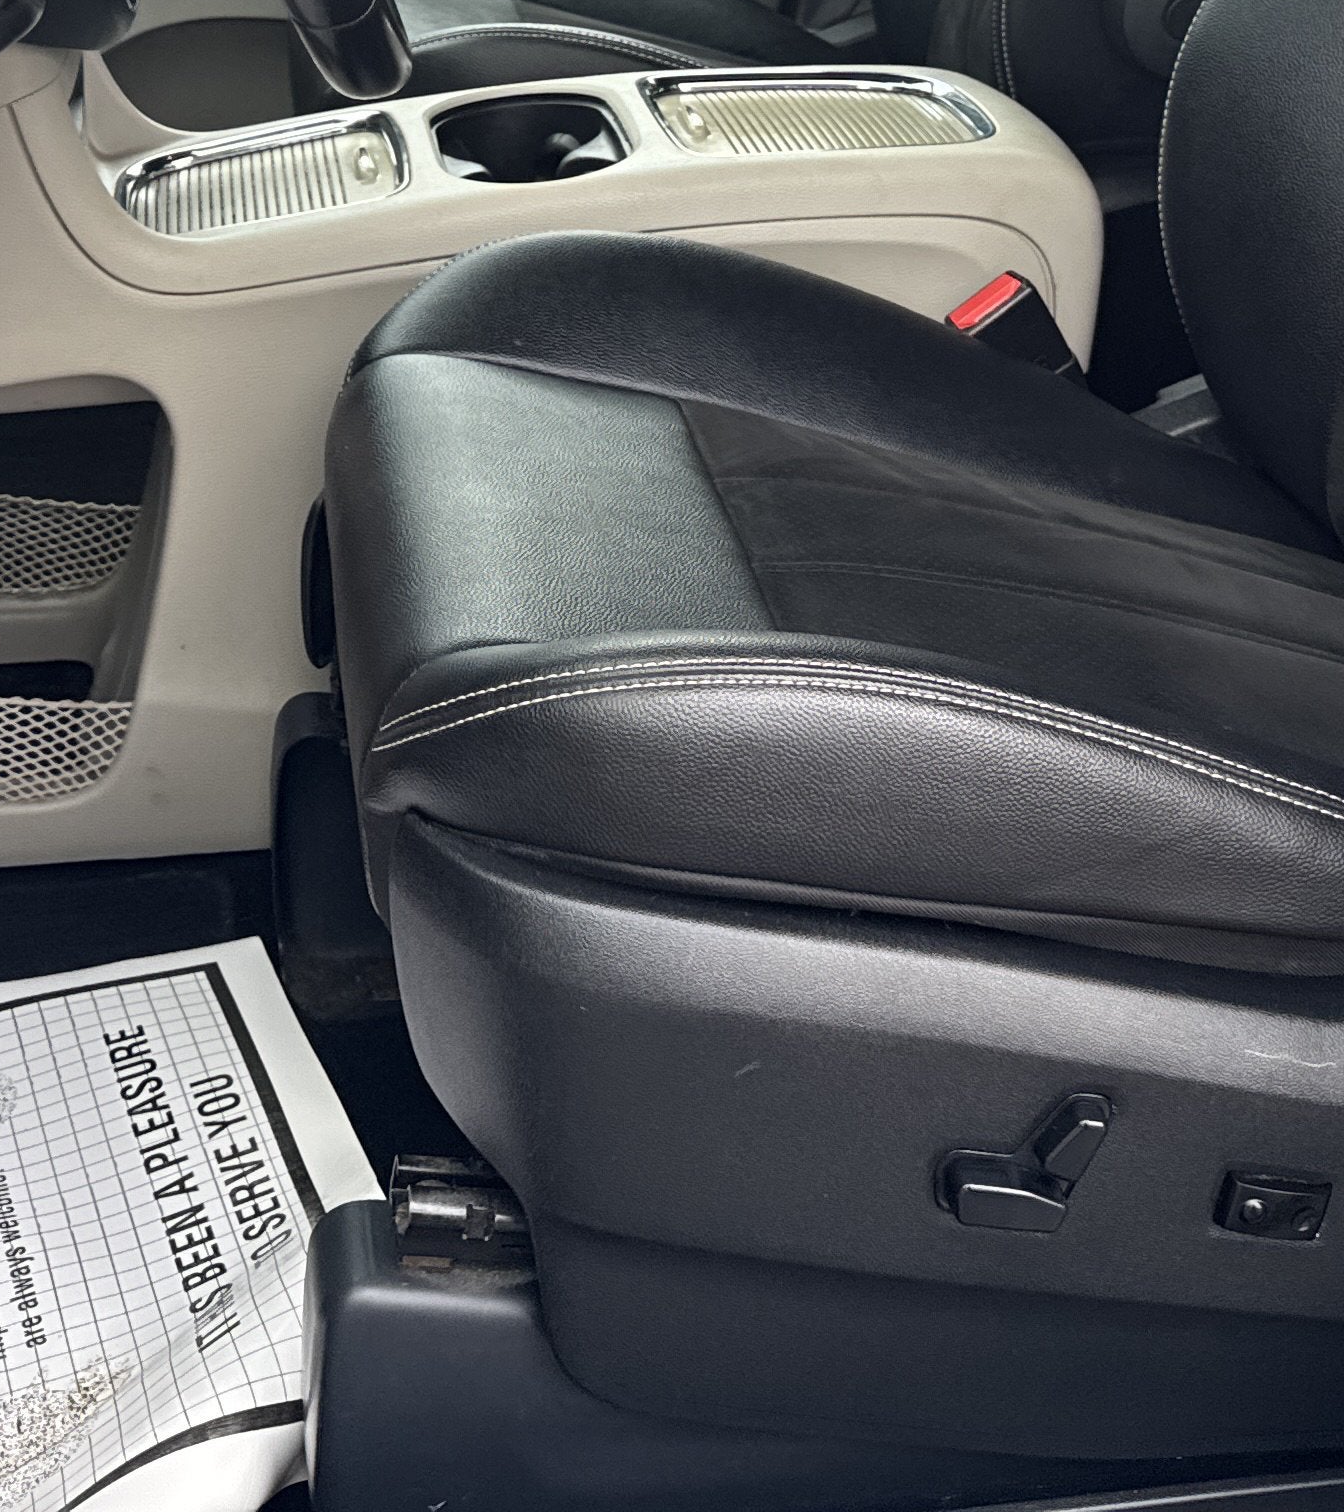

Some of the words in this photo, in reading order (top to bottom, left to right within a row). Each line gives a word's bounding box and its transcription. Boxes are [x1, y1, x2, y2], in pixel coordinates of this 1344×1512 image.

[103, 1024, 189, 1174] PLEASURE
[189, 1073, 247, 1140] YOU
[152, 1171, 199, 1201] A
[213, 1137, 287, 1241] SERVE
[5, 1245, 39, 1311] always
[160, 1204, 227, 1291] BEEN
[21, 1316, 47, 1348] are
[195, 1312, 241, 1352] IT
